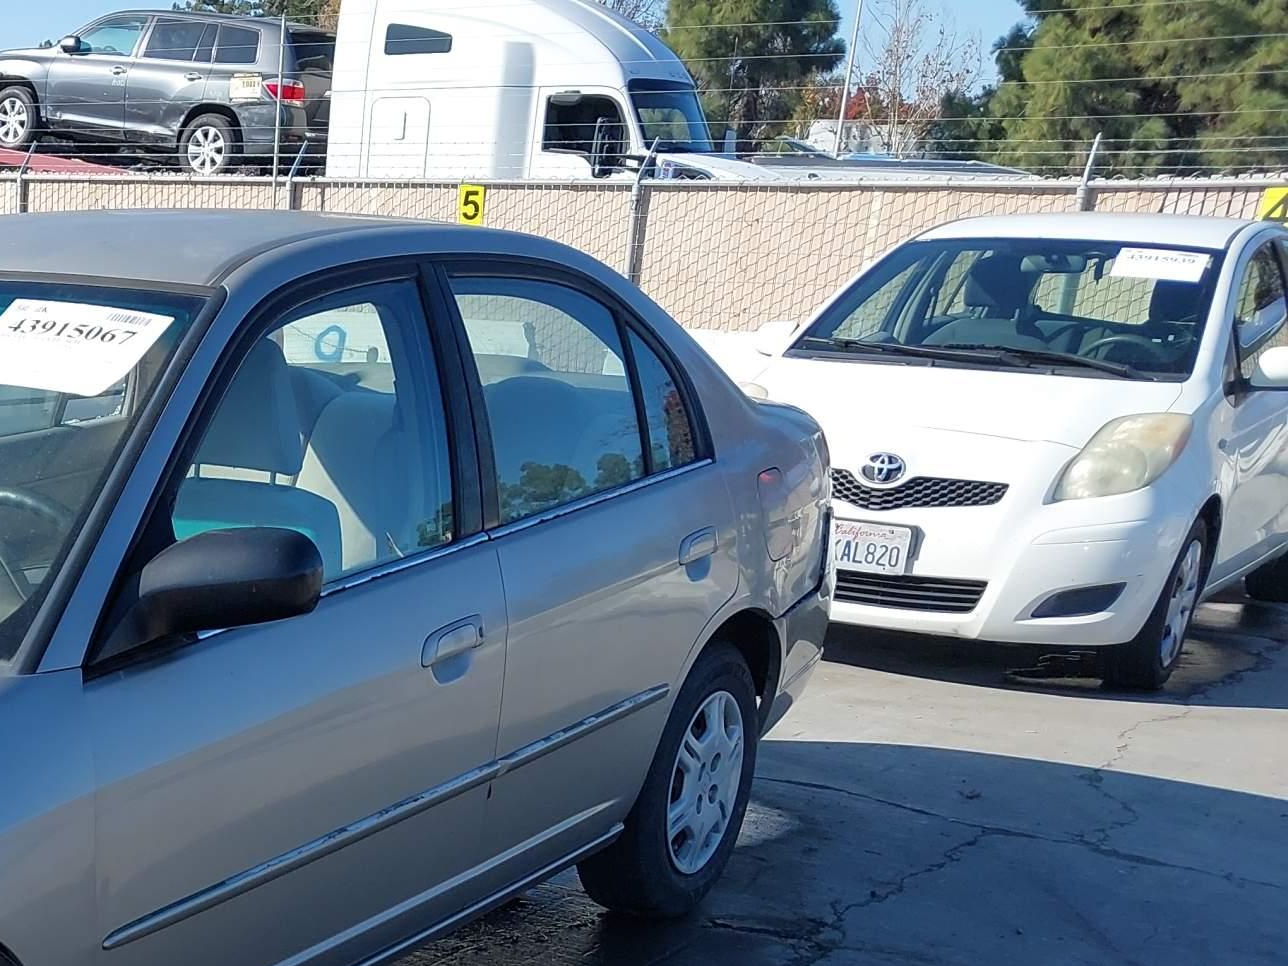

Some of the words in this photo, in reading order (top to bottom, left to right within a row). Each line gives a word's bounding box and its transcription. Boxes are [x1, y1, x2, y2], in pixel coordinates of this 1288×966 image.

[462, 190, 480, 221] 5
[1262, 192, 1288, 221] 4
[7, 317, 139, 346] 43915067
